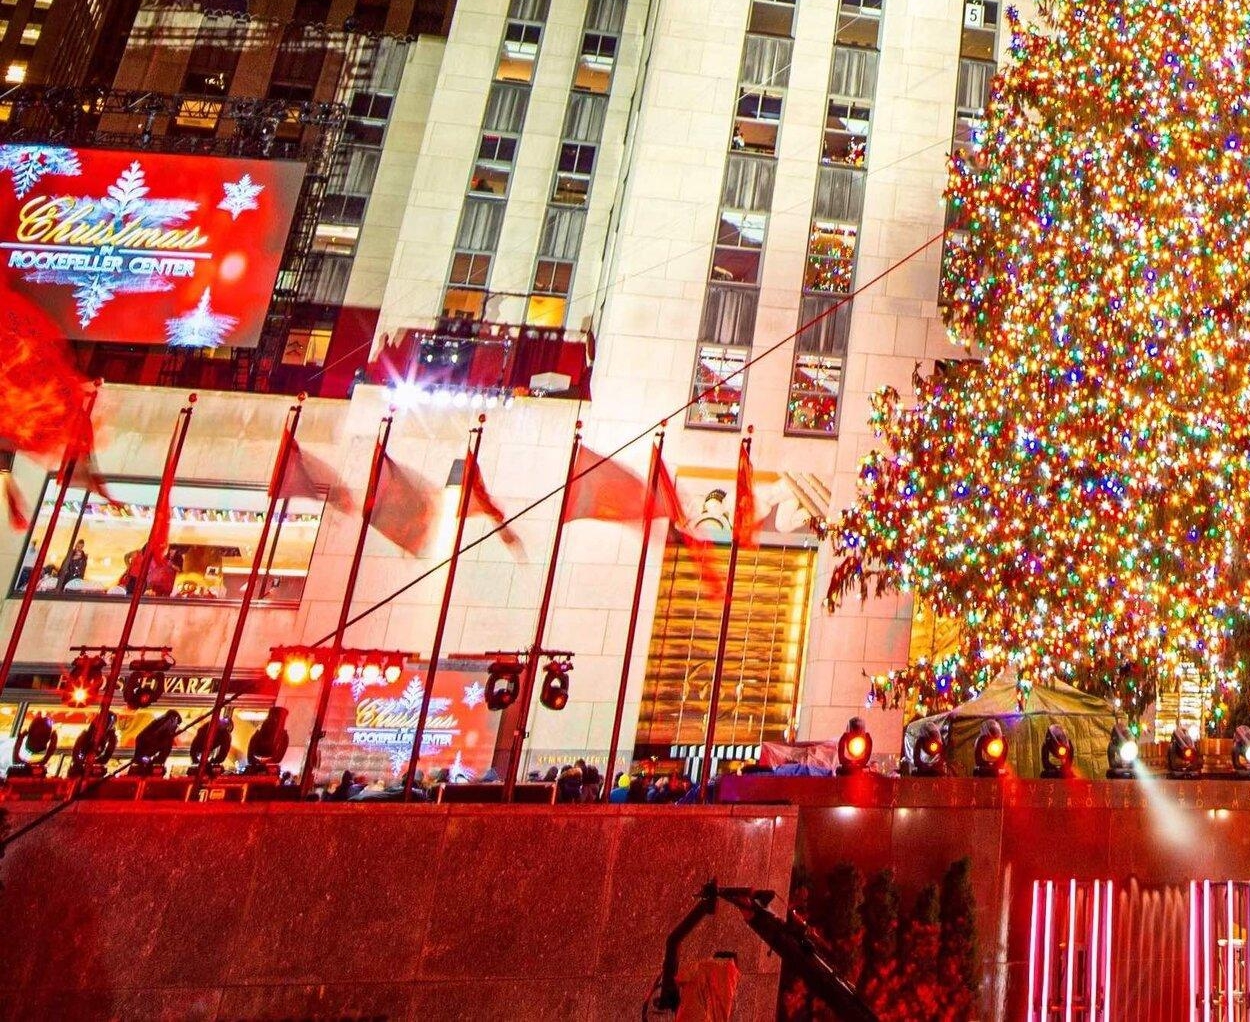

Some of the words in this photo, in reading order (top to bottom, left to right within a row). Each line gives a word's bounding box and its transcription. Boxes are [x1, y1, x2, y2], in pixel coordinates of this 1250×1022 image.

[970, 8, 977, 21] 5
[17, 195, 209, 250] Christmas
[8, 250, 124, 273] ROCKEFELLER
[128, 259, 196, 277] CENTER
